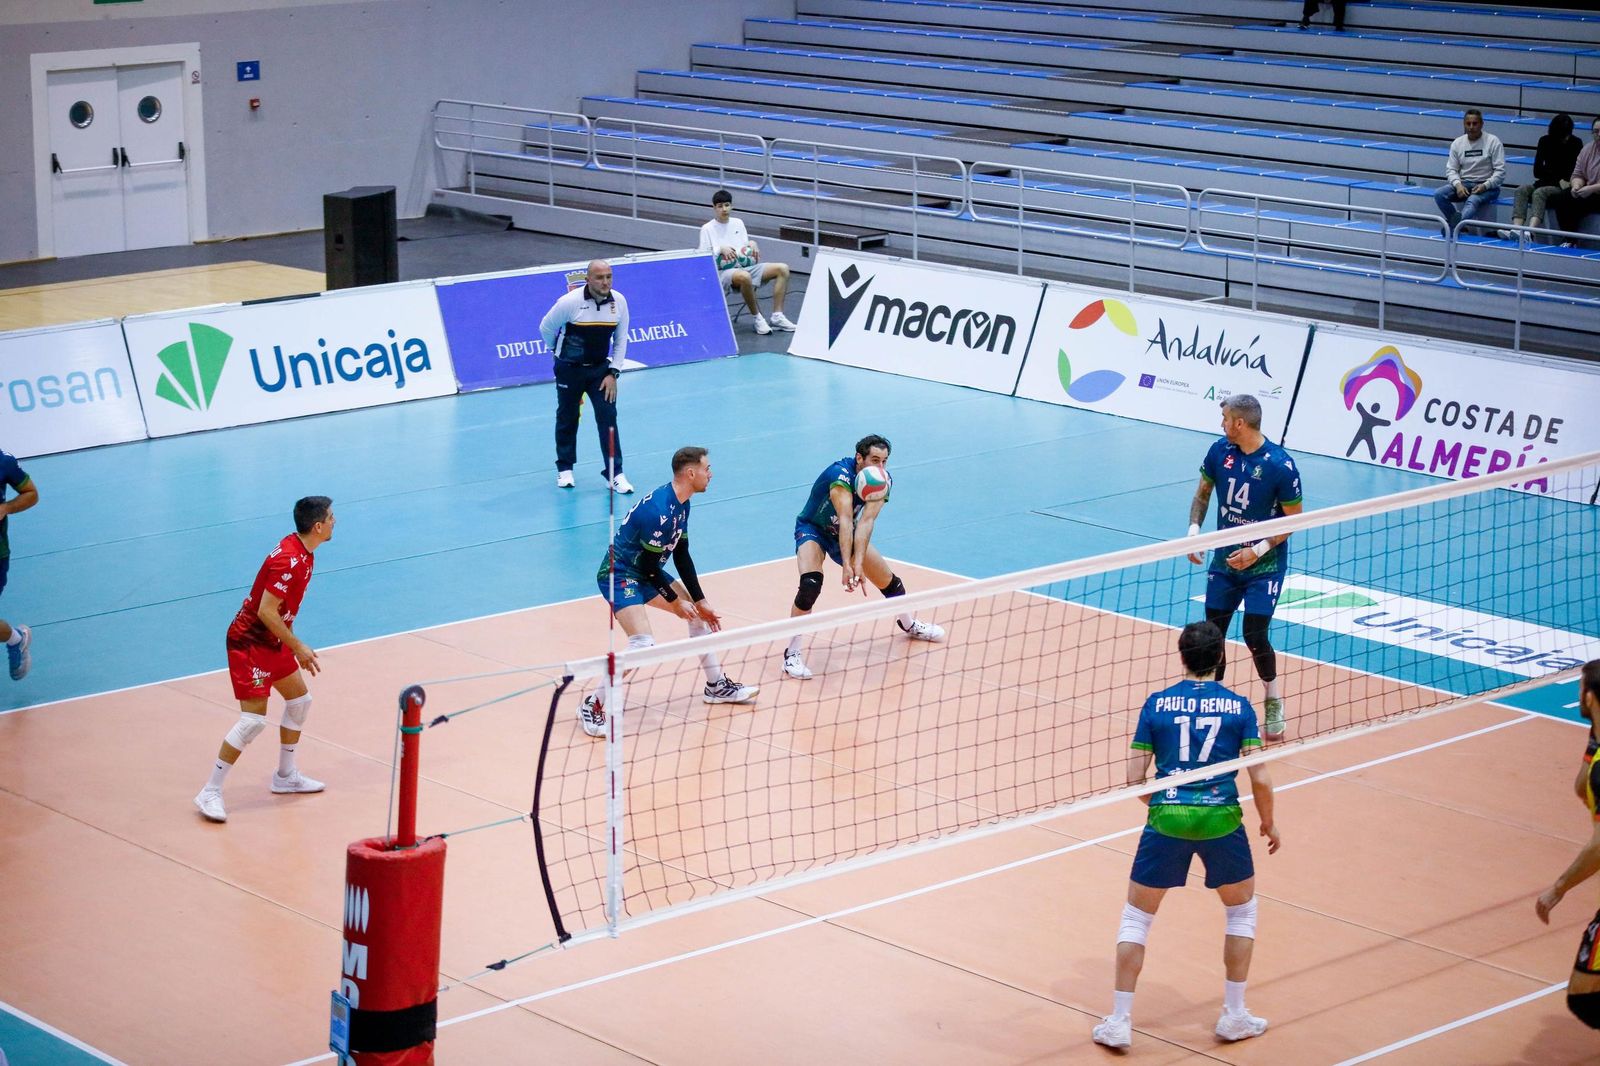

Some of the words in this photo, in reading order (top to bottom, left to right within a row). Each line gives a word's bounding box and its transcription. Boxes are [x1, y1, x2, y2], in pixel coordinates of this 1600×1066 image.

[864, 294, 1016, 355] macron
[249, 329, 432, 389] Unicaja
[496, 339, 555, 359] DIPUTA
[1145, 317, 1273, 379] Andalucía
[0, 367, 123, 412] osan
[1424, 398, 1515, 437] COSTA
[1522, 414, 1564, 444] DE
[1380, 432, 1548, 493] ALMERÍA
[1226, 477, 1250, 510] 14
[1267, 580, 1279, 596] 14
[1353, 612, 1586, 671] Unicaja
[1155, 696, 1196, 713] PAULO
[1200, 698, 1242, 715] RENAN
[1174, 715, 1222, 762] 17
